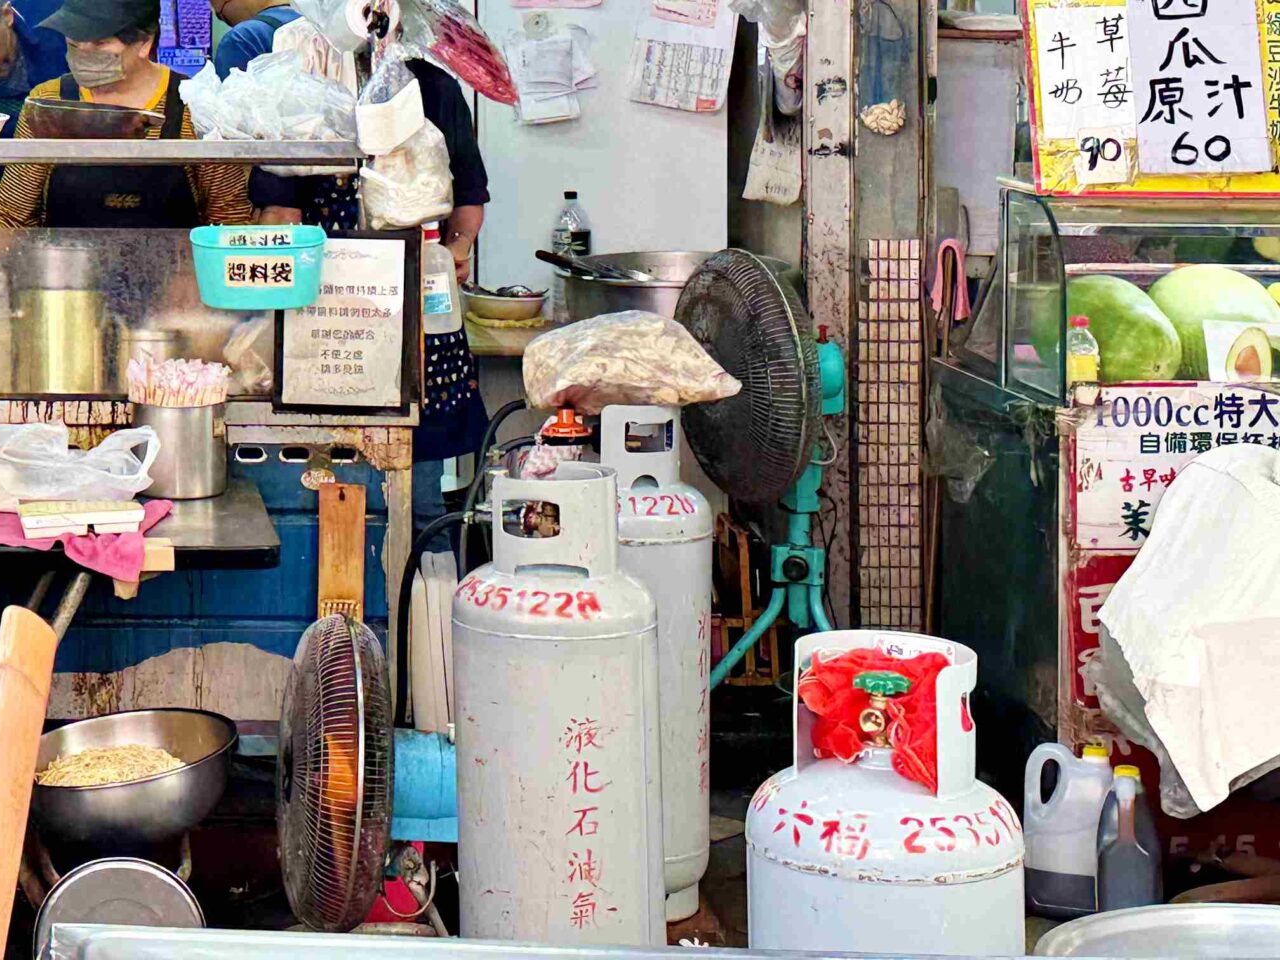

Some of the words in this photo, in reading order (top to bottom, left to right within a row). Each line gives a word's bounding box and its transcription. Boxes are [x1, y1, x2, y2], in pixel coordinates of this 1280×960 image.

[1047, 32, 1083, 104] 牛奶
[1096, 14, 1133, 108] 草莓
[1139, 75, 1253, 124] 原汁
[1080, 136, 1122, 171] 90
[1170, 131, 1232, 165] 60
